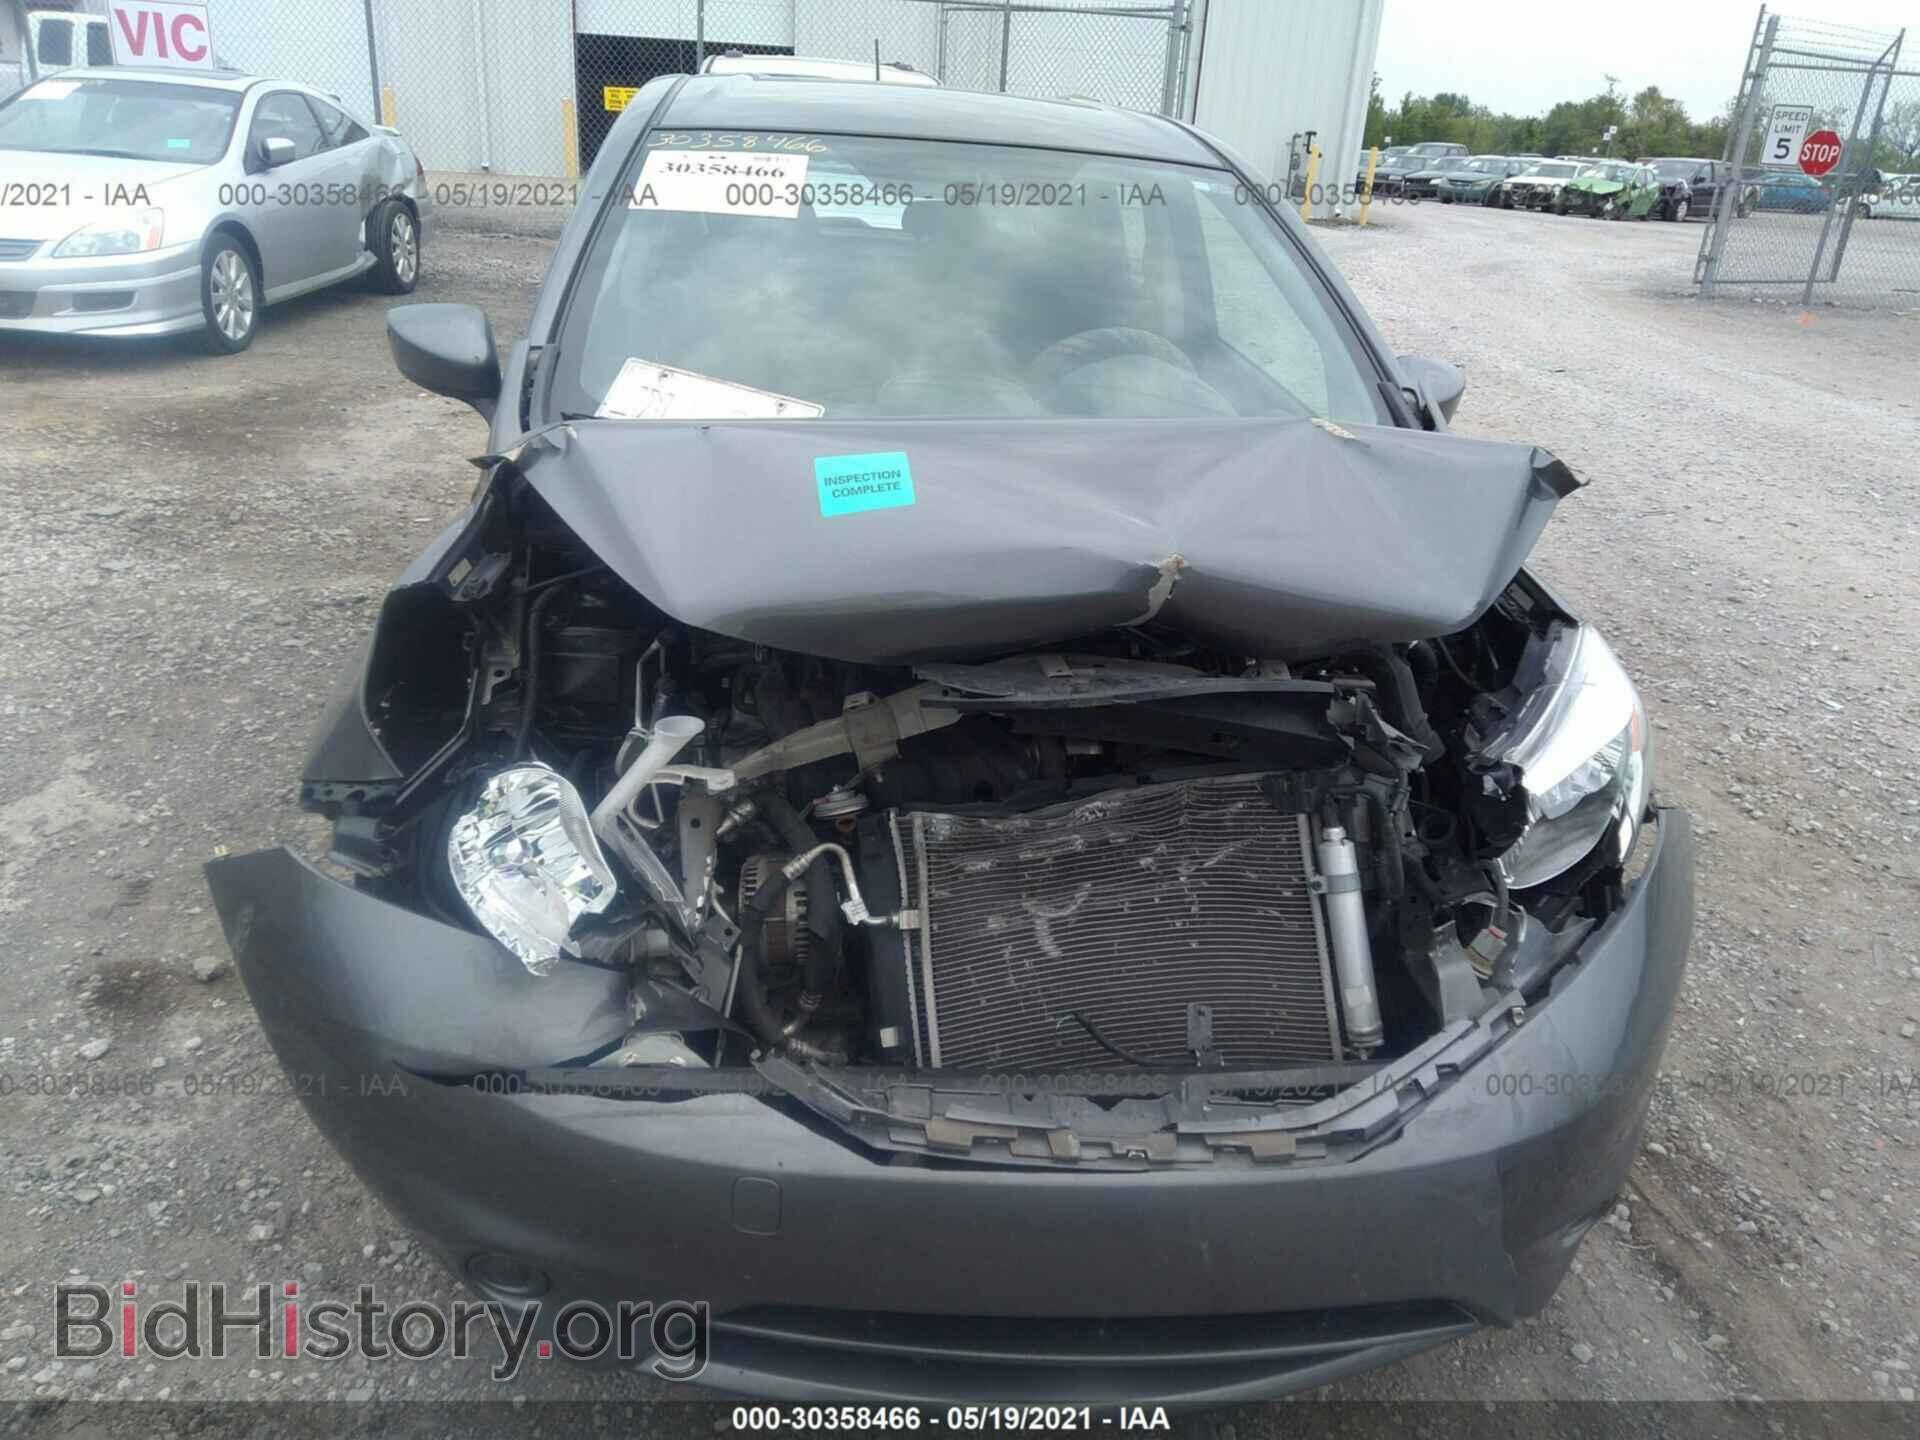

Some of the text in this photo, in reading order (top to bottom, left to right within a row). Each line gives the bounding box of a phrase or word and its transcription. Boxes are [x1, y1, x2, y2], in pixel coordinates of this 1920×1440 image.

[114, 9, 208, 62] VIC
[1774, 111, 1809, 121] SPEED
[1774, 124, 1802, 134] LIMIT
[647, 133, 829, 153] 30358466
[1773, 138, 1792, 160] 5
[1800, 143, 1840, 162] STOP
[824, 469, 901, 487] INSPECTION
[832, 481, 902, 498] COMPLETE
